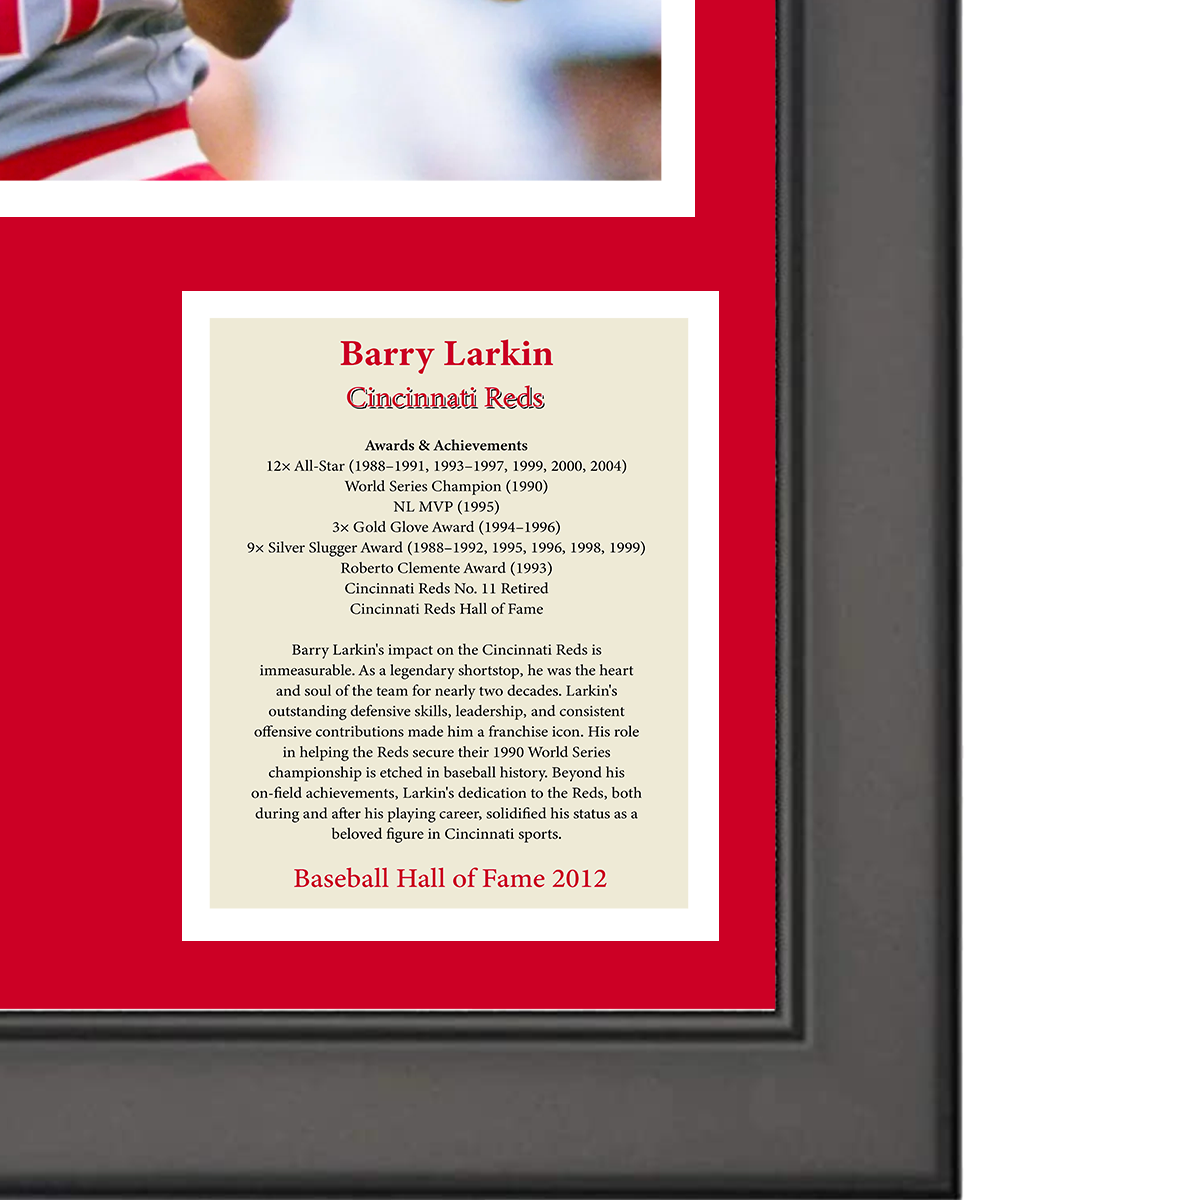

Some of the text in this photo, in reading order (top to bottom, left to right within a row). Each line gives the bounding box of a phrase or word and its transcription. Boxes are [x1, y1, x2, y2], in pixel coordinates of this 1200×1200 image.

[340, 338, 554, 375] Barry Larkin
[346, 384, 546, 410] Cincinnati Reds
[364, 438, 529, 452] Awards & Achievements
[293, 459, 346, 472] All-Star
[513, 459, 547, 474] 1999,
[551, 459, 587, 474] 2000,
[590, 458, 627, 475] 2004)
[344, 479, 549, 496] World Series Champion (1990)
[393, 499, 500, 516] NL MVP (1995)
[352, 520, 387, 534] Gold
[389, 520, 429, 534] Glove
[431, 520, 475, 533] Award
[267, 540, 306, 554] Silver
[308, 540, 358, 558] Slugger
[360, 540, 403, 554] Award
[492, 541, 527, 555] 1995,
[531, 541, 566, 555] 1996,
[570, 541, 605, 555] 1998,
[610, 540, 646, 556] 1999)
[340, 561, 553, 577] Roberto Clemente Award (1993)
[344, 581, 549, 595] Cincinnati Reds No. 11 Retired
[349, 601, 544, 616] Cincinnati Reds Hall of Fame
[291, 642, 602, 660] Barry Larkin's impact on the Cincinnati Reds is
[259, 663, 634, 681] immeasurable. As a legendary shortstop, he was the heart
[275, 683, 618, 701] and soul of the team for nearly two decades. Larkin's
[268, 704, 626, 721] outstanding defensive skills, leadership, and consistent
[253, 724, 640, 738] offensive contributions made him a franchise icon. His role
[282, 745, 611, 762] in helping the Reds secure their 1990 World Series
[268, 765, 626, 783] championship is etched in baseball history. Beyond his
[250, 785, 642, 801] on-field achievements, Larkin's dedication to the Reds, both
[254, 806, 639, 824] during and after his playing career, solidified his status as a
[331, 826, 562, 844] beloved figure in Cincinnati sports.
[293, 866, 608, 889] Baseball Hall of Fame 2012
